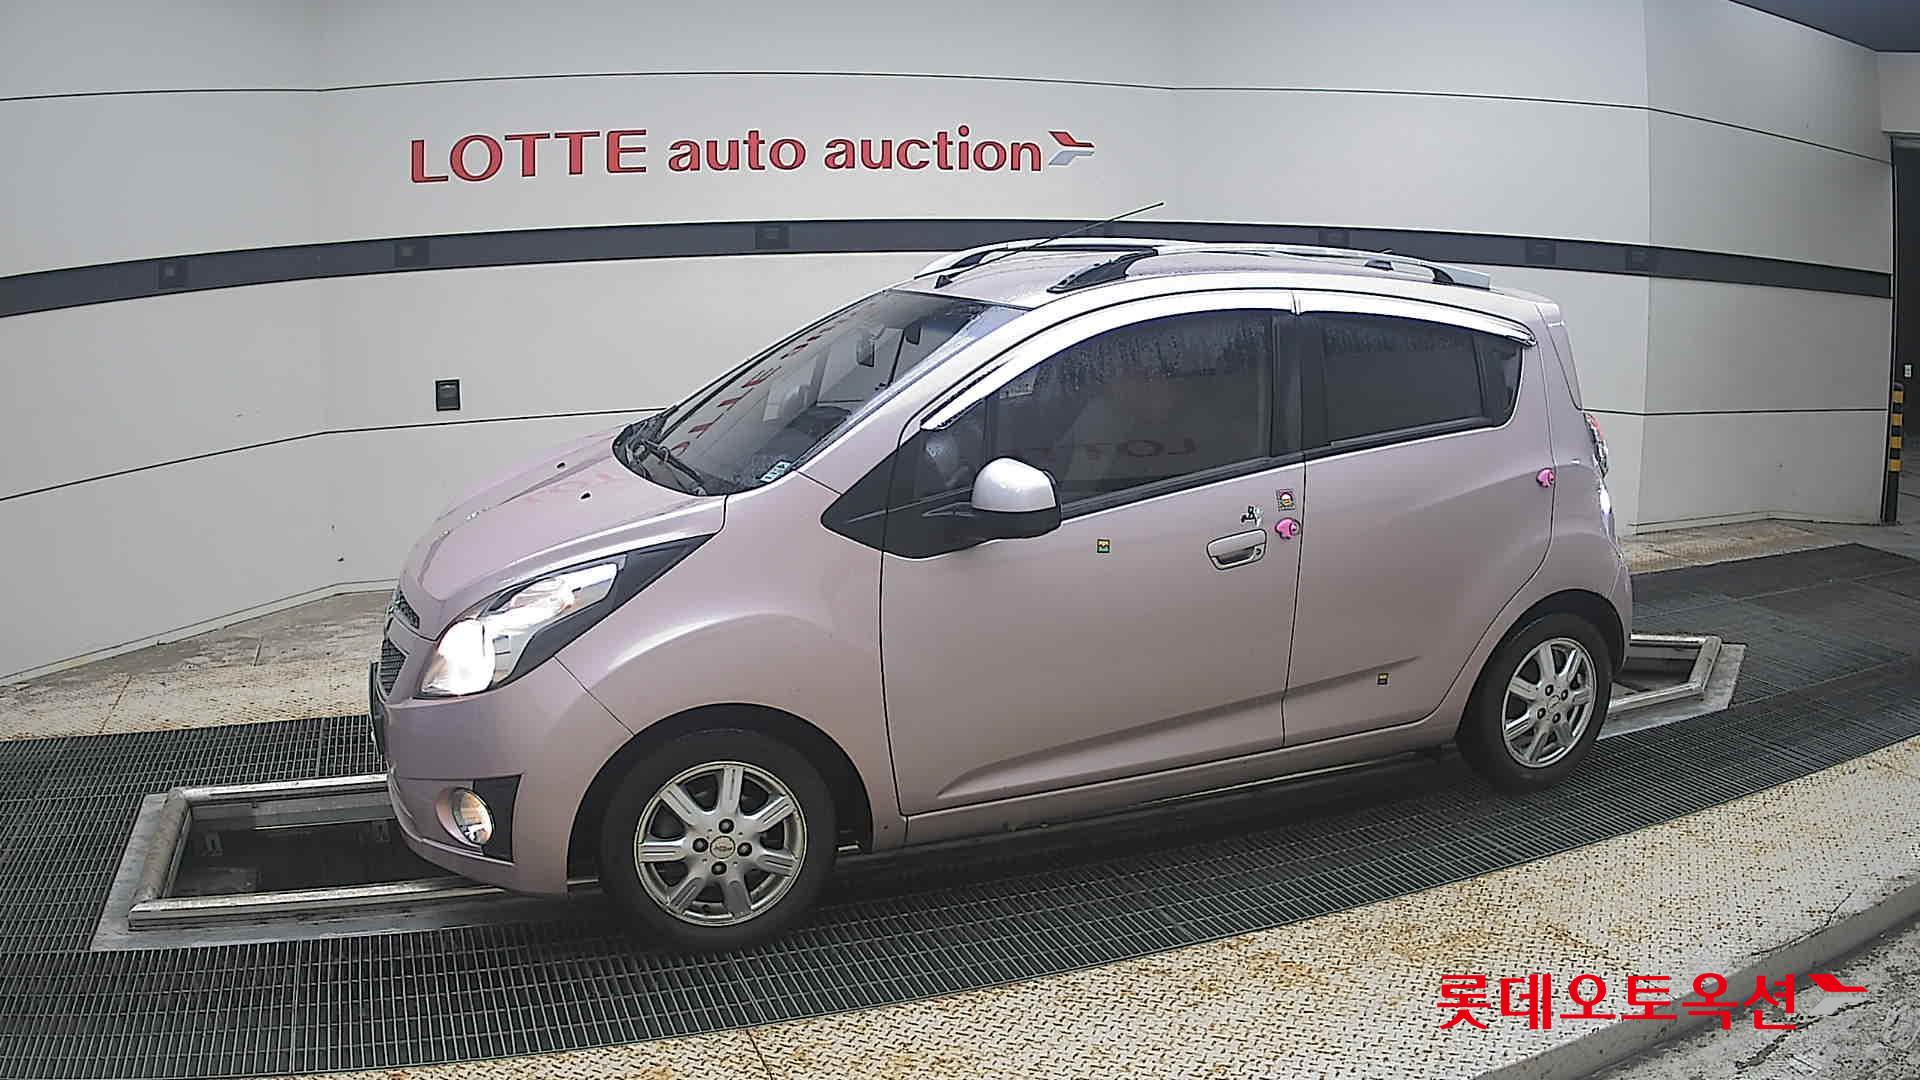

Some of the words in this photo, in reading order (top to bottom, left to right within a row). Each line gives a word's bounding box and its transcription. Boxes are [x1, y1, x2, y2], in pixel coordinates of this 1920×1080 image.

[410, 129, 647, 184] LOTTE
[667, 130, 806, 172] auto
[823, 125, 1042, 172] auction
